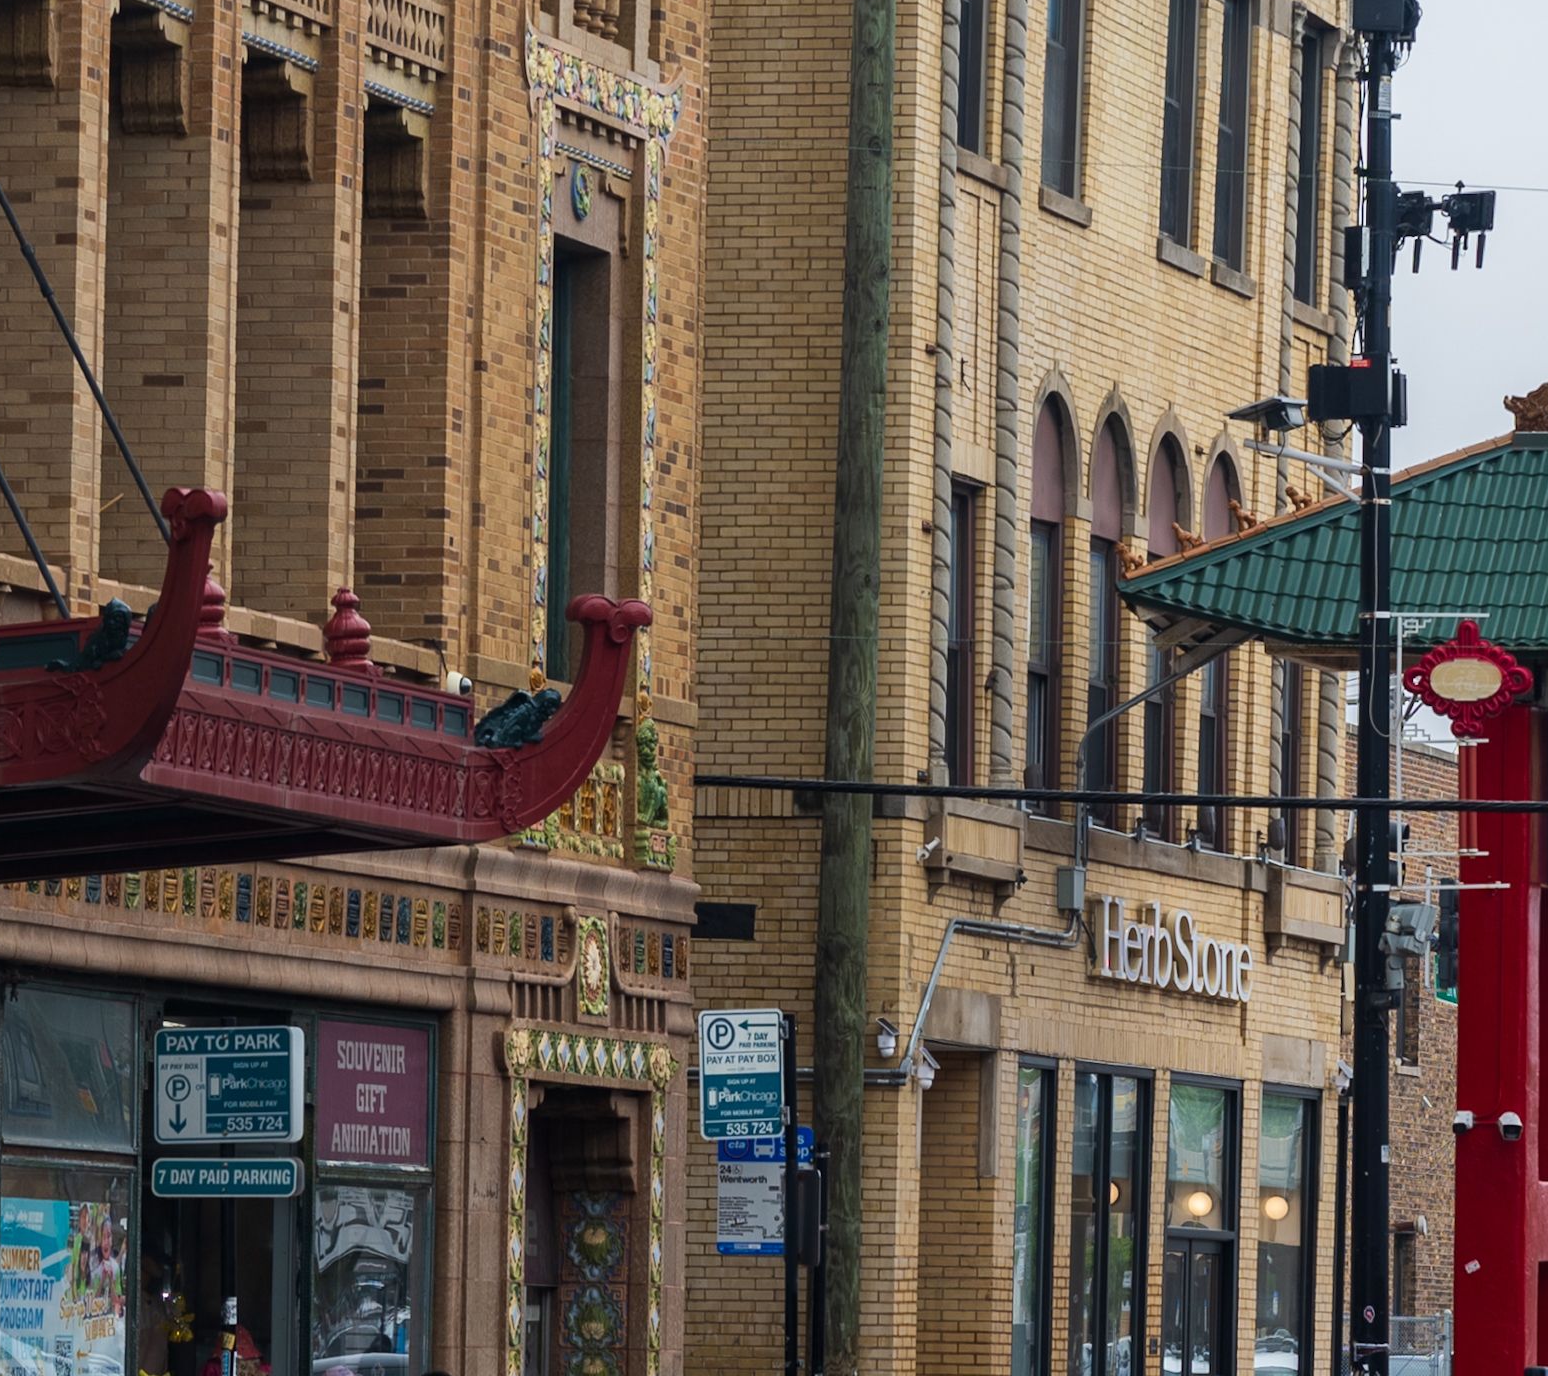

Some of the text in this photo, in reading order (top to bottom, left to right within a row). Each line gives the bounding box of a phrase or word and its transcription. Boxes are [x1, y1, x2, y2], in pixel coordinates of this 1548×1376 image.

[1101, 896, 1253, 1003] HerbStone
[166, 1034, 281, 1052] PAY TO PARK
[747, 1032, 768, 1041] 7 DAY
[337, 1040, 406, 1074] SOUVENIR
[706, 1054, 777, 1064] PAY AT PAY BOX
[170, 1063, 183, 1071] PAY
[172, 1079, 186, 1098] P
[222, 1076, 287, 1092] ParkChicago
[356, 1083, 387, 1114] GIFT
[718, 1089, 777, 1104] ParkChicago
[227, 1117, 253, 1131] 535
[258, 1117, 283, 1131] 724
[726, 1122, 773, 1135] 535 724
[331, 1123, 411, 1156] ANIMATION
[158, 1169, 291, 1185] 7 DAY PAID PARKING
[719, 1165, 731, 1173] 24
[719, 1175, 767, 1184] Wentworth
[0, 1247, 40, 1271] SUMMER
[0, 1278, 54, 1302] JUMPSTART
[0, 1307, 44, 1330] PROGRAM
